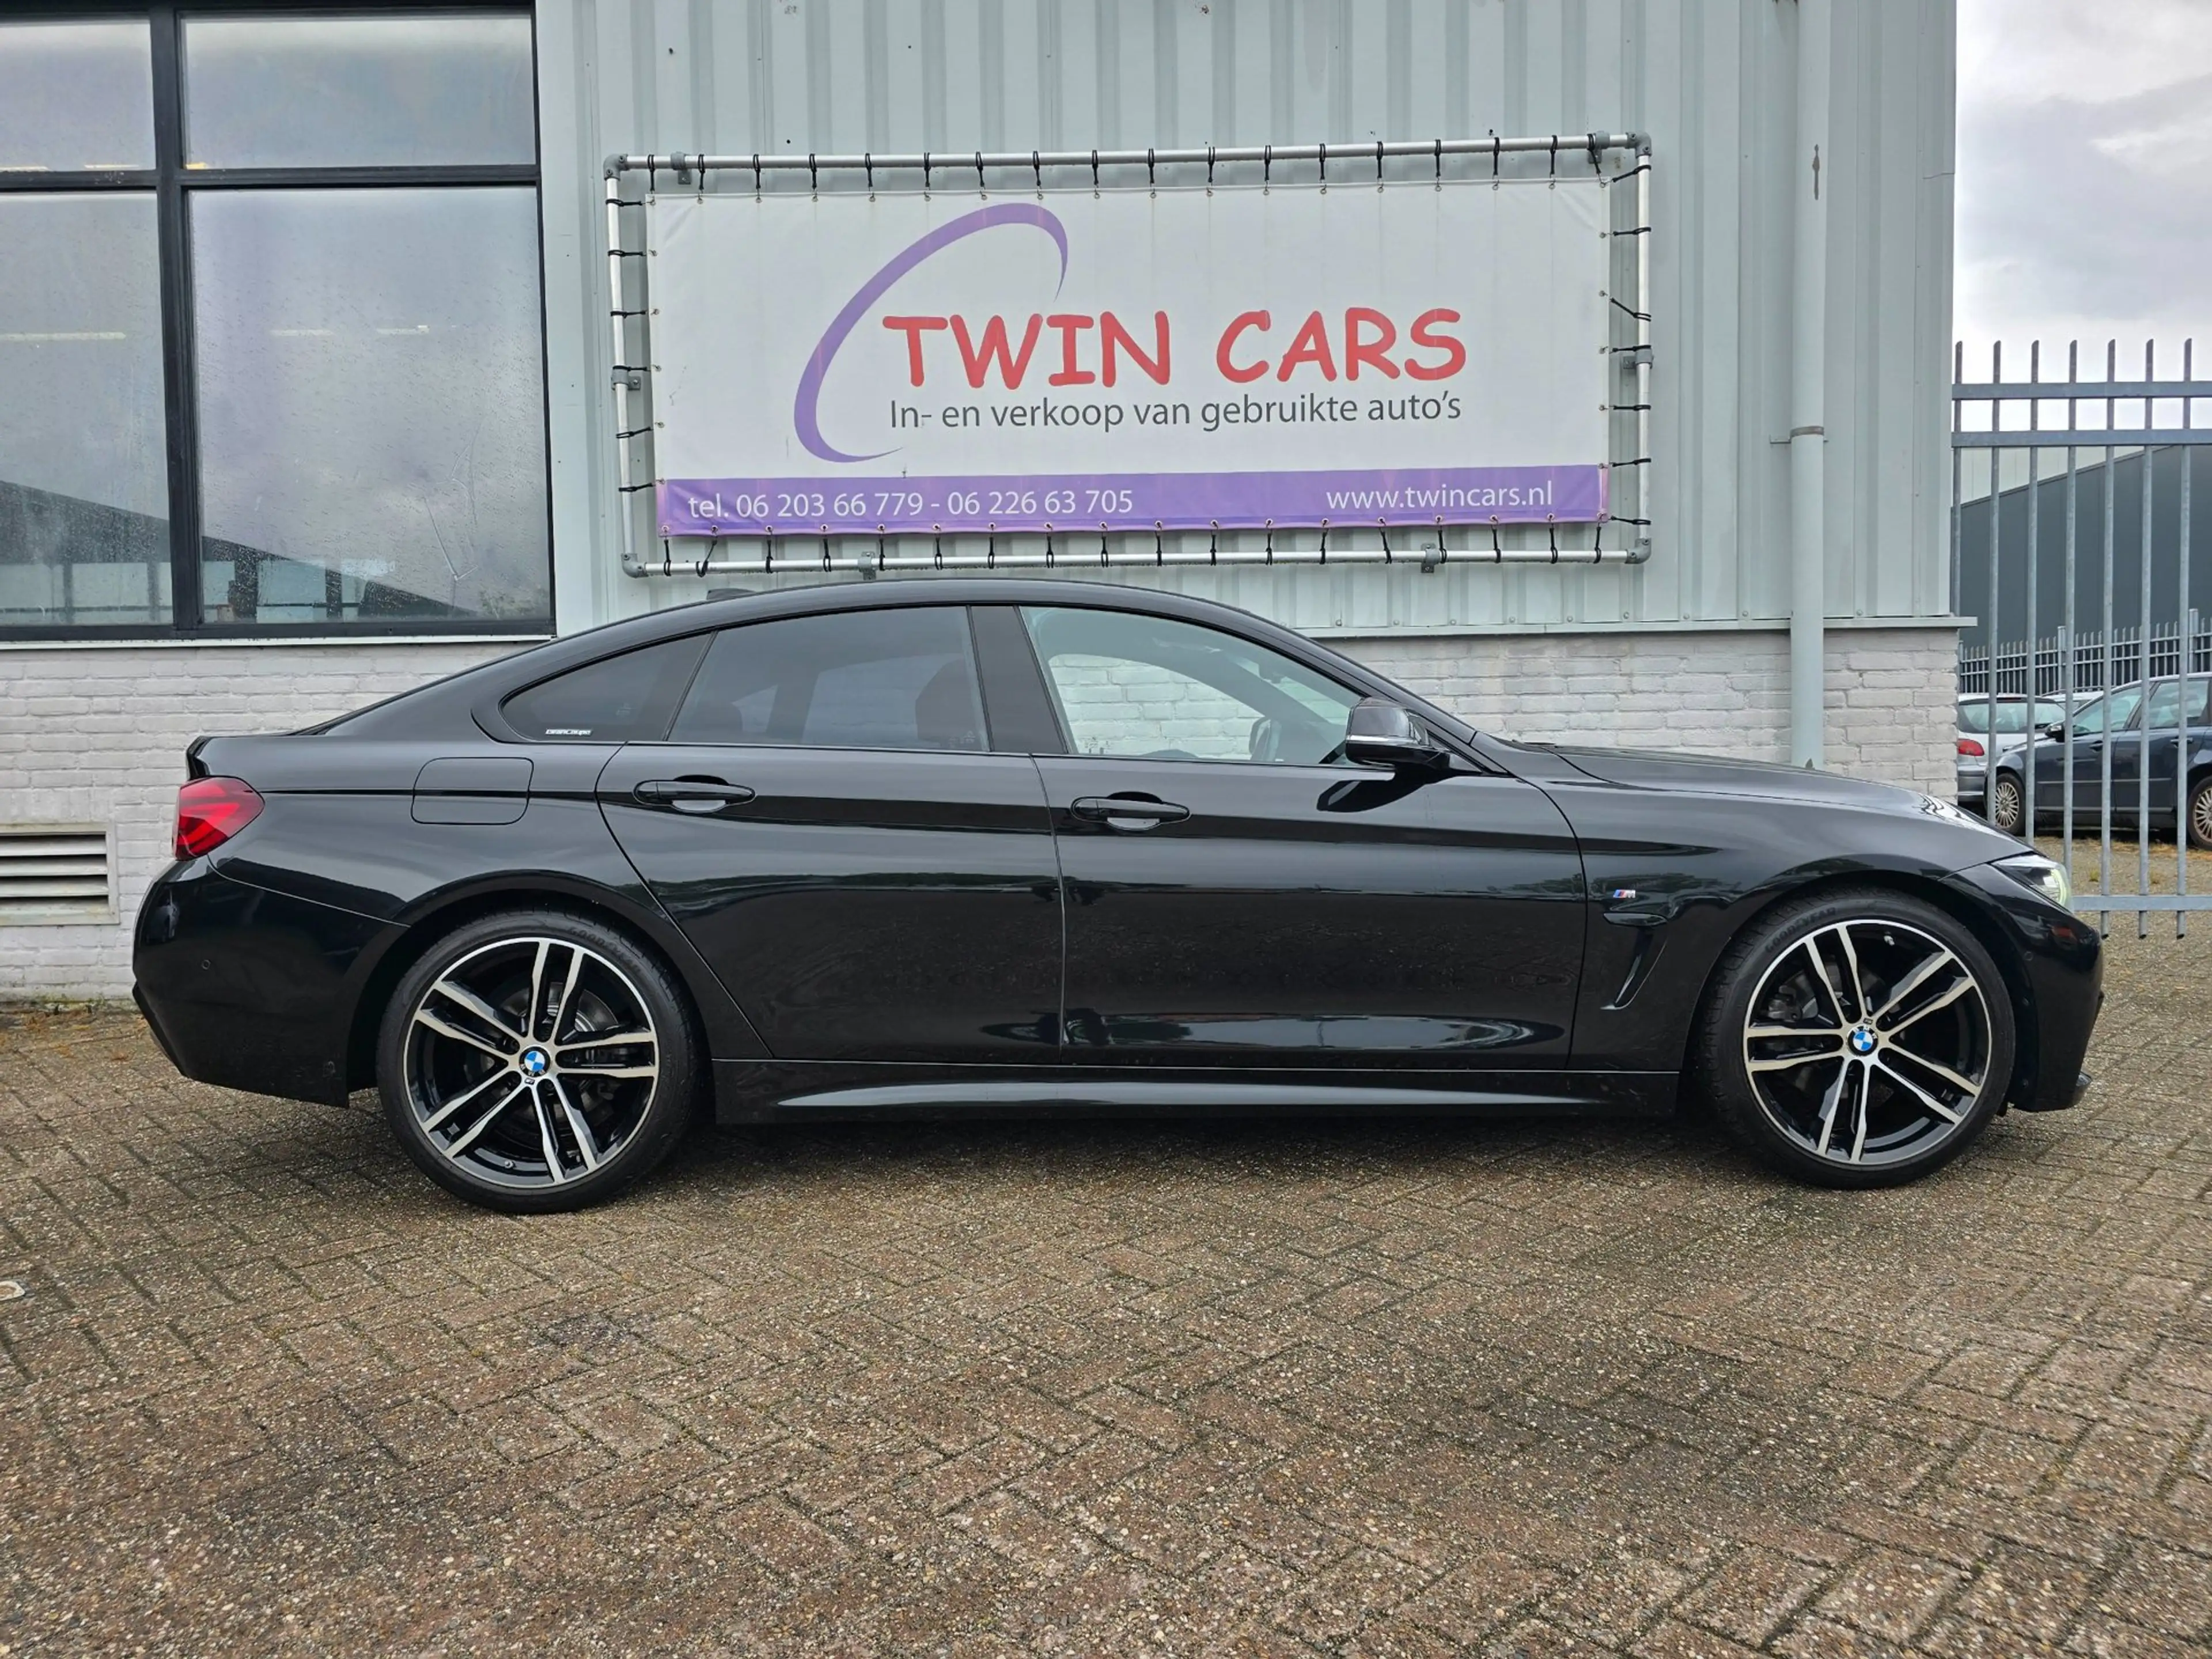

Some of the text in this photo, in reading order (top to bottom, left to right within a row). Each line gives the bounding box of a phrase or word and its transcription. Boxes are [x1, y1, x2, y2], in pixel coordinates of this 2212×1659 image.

[882, 307, 1466, 390] TWIN CARS
[892, 401, 931, 427] In-
[943, 407, 979, 427] en
[991, 397, 1123, 432] verkoop
[1134, 404, 1189, 424] van
[1202, 393, 1357, 431] gebruikte
[688, 494, 728, 517] tel.
[737, 495, 768, 517] 06
[778, 494, 824, 516] 203
[834, 494, 866, 516] 66
[875, 493, 922, 515] 779
[948, 493, 979, 514] 06
[989, 491, 1036, 514] 226
[1046, 491, 1075, 513] 63
[1086, 490, 1132, 513] 705
[1327, 481, 1551, 509] www.twincars.nl
